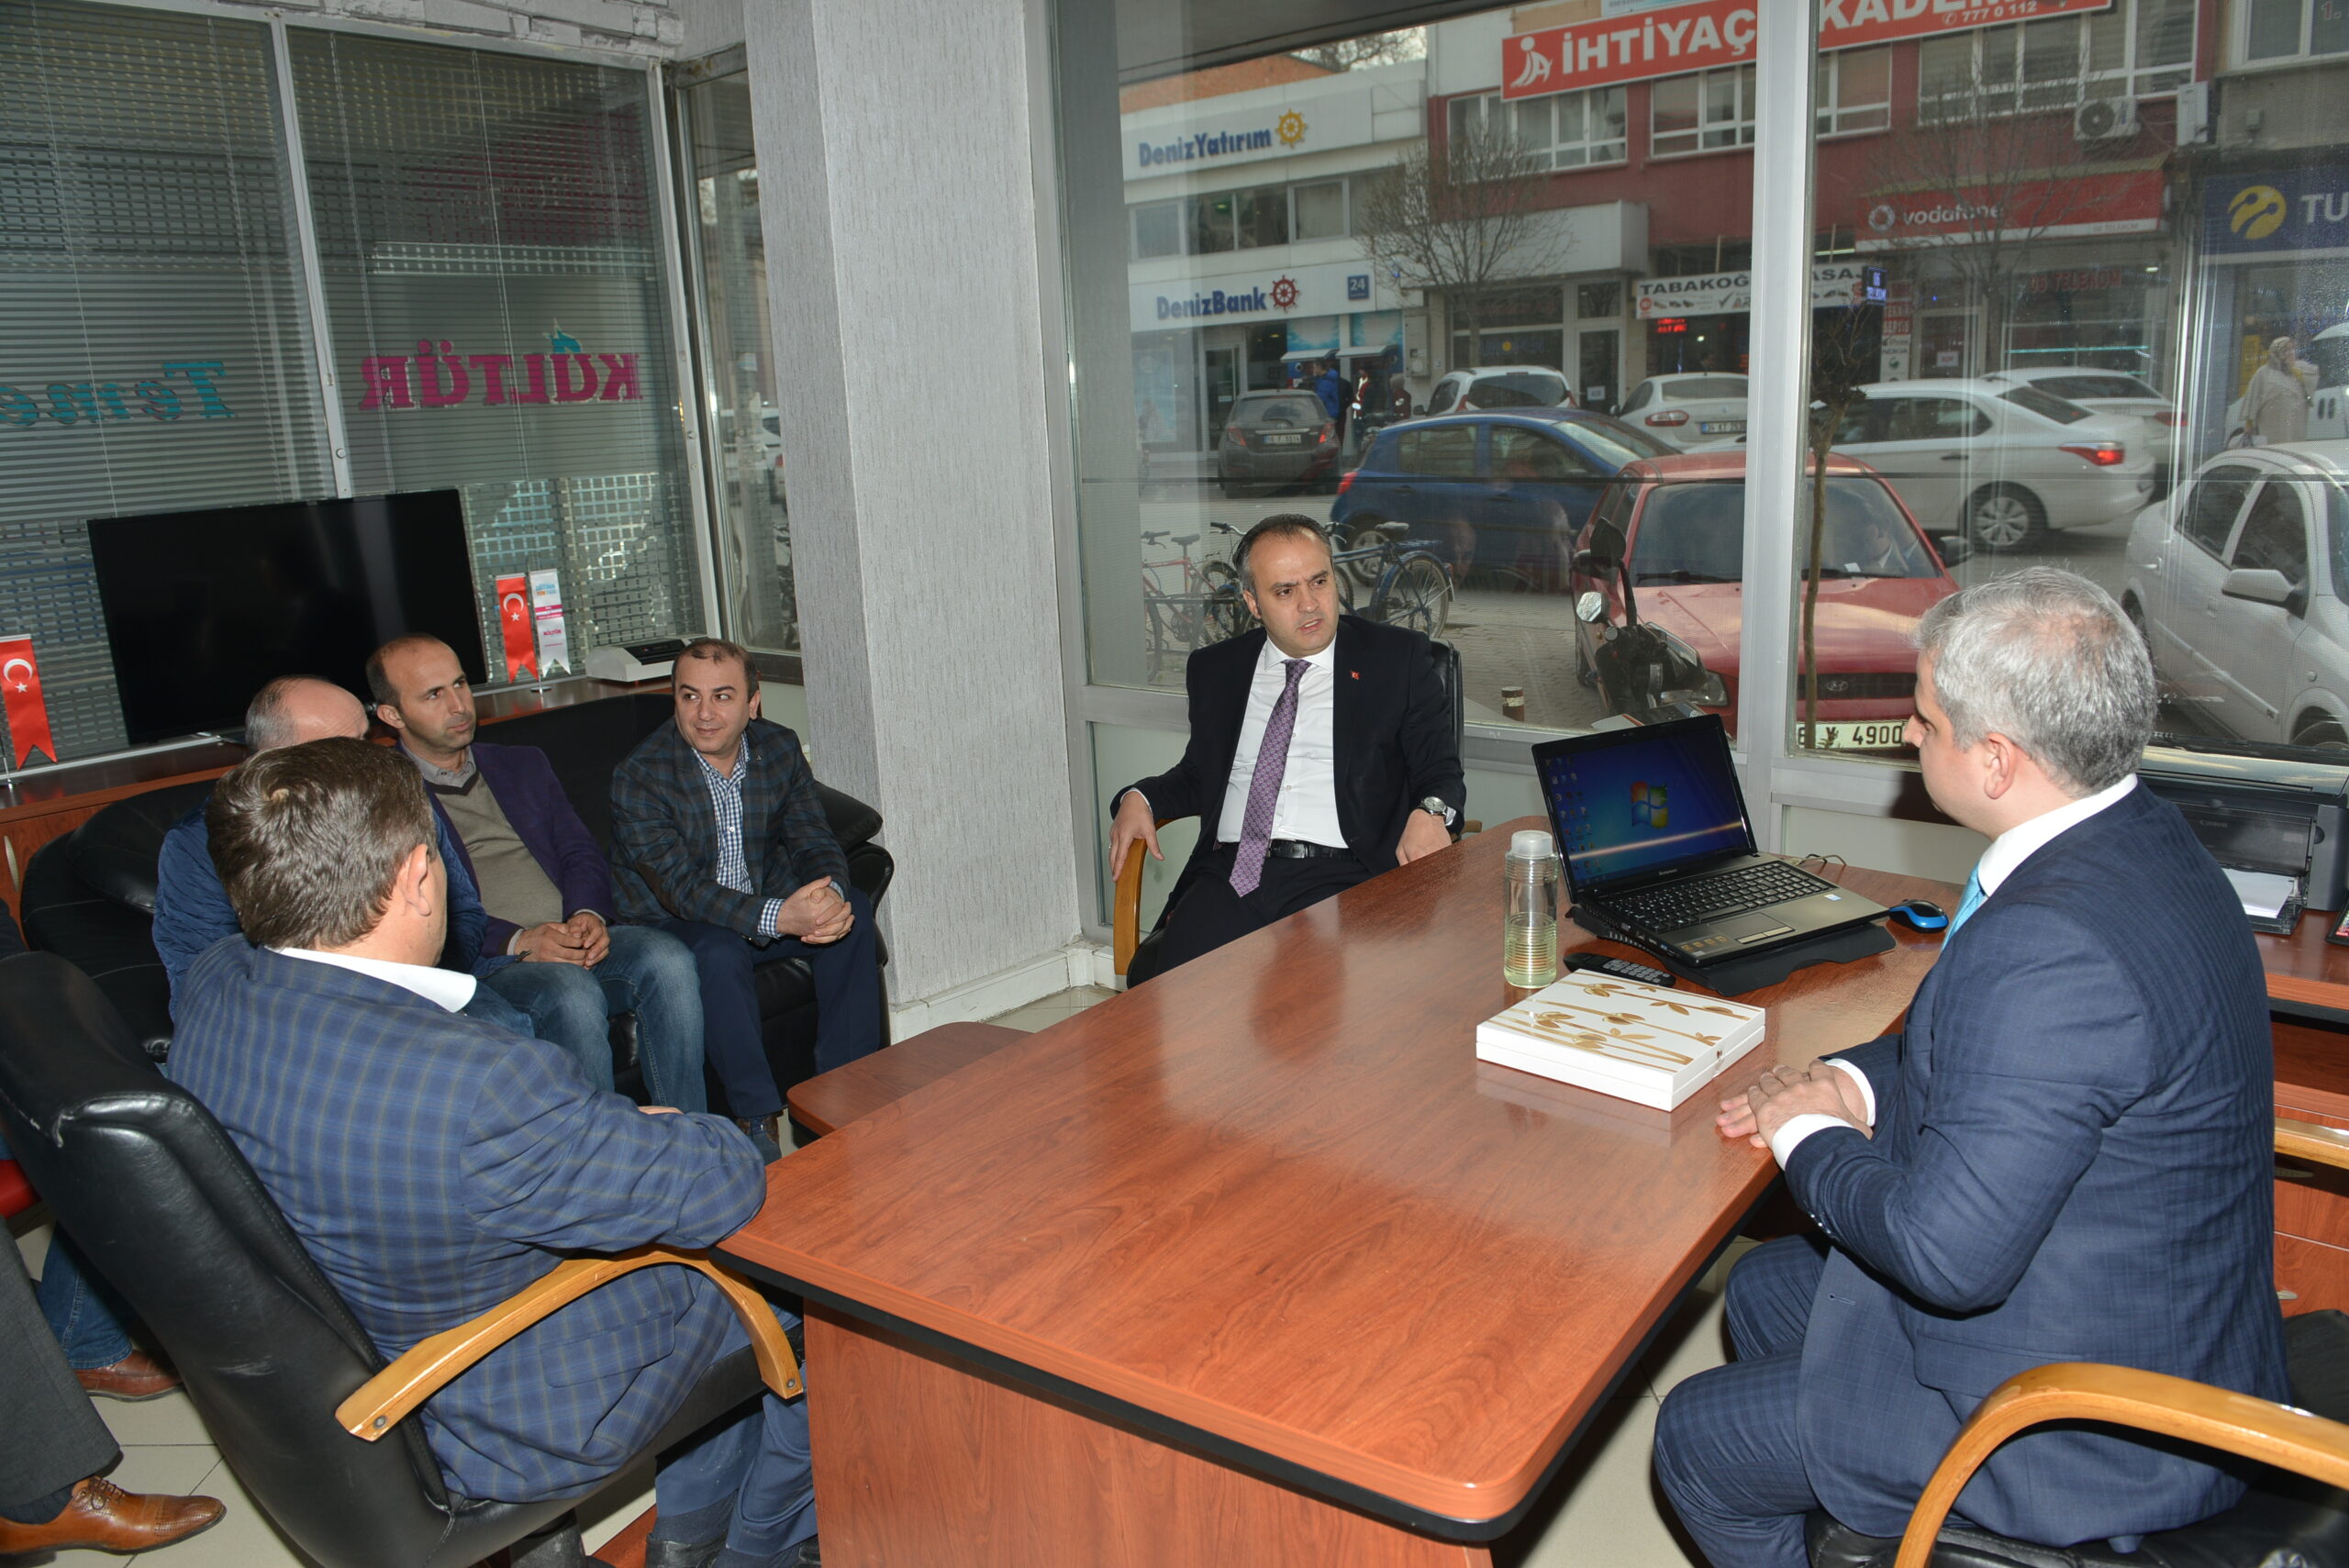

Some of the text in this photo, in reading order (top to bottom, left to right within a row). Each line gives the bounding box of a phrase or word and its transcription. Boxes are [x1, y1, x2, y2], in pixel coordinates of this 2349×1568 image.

[1962, 3, 2037, 23] 777 0 112
[1563, 8, 1756, 74] İHTİYAÇ
[1139, 128, 1273, 167] DenizYatırım
[1903, 202, 2001, 226] vodafone
[2300, 192, 2349, 225] TU
[1350, 278, 1366, 291] 24
[1640, 272, 1750, 295] TABAKOĞ
[2054, 269, 2122, 291] TELEKOM
[1157, 286, 1267, 319] DenizBank
[1852, 725, 1903, 746] 4900
